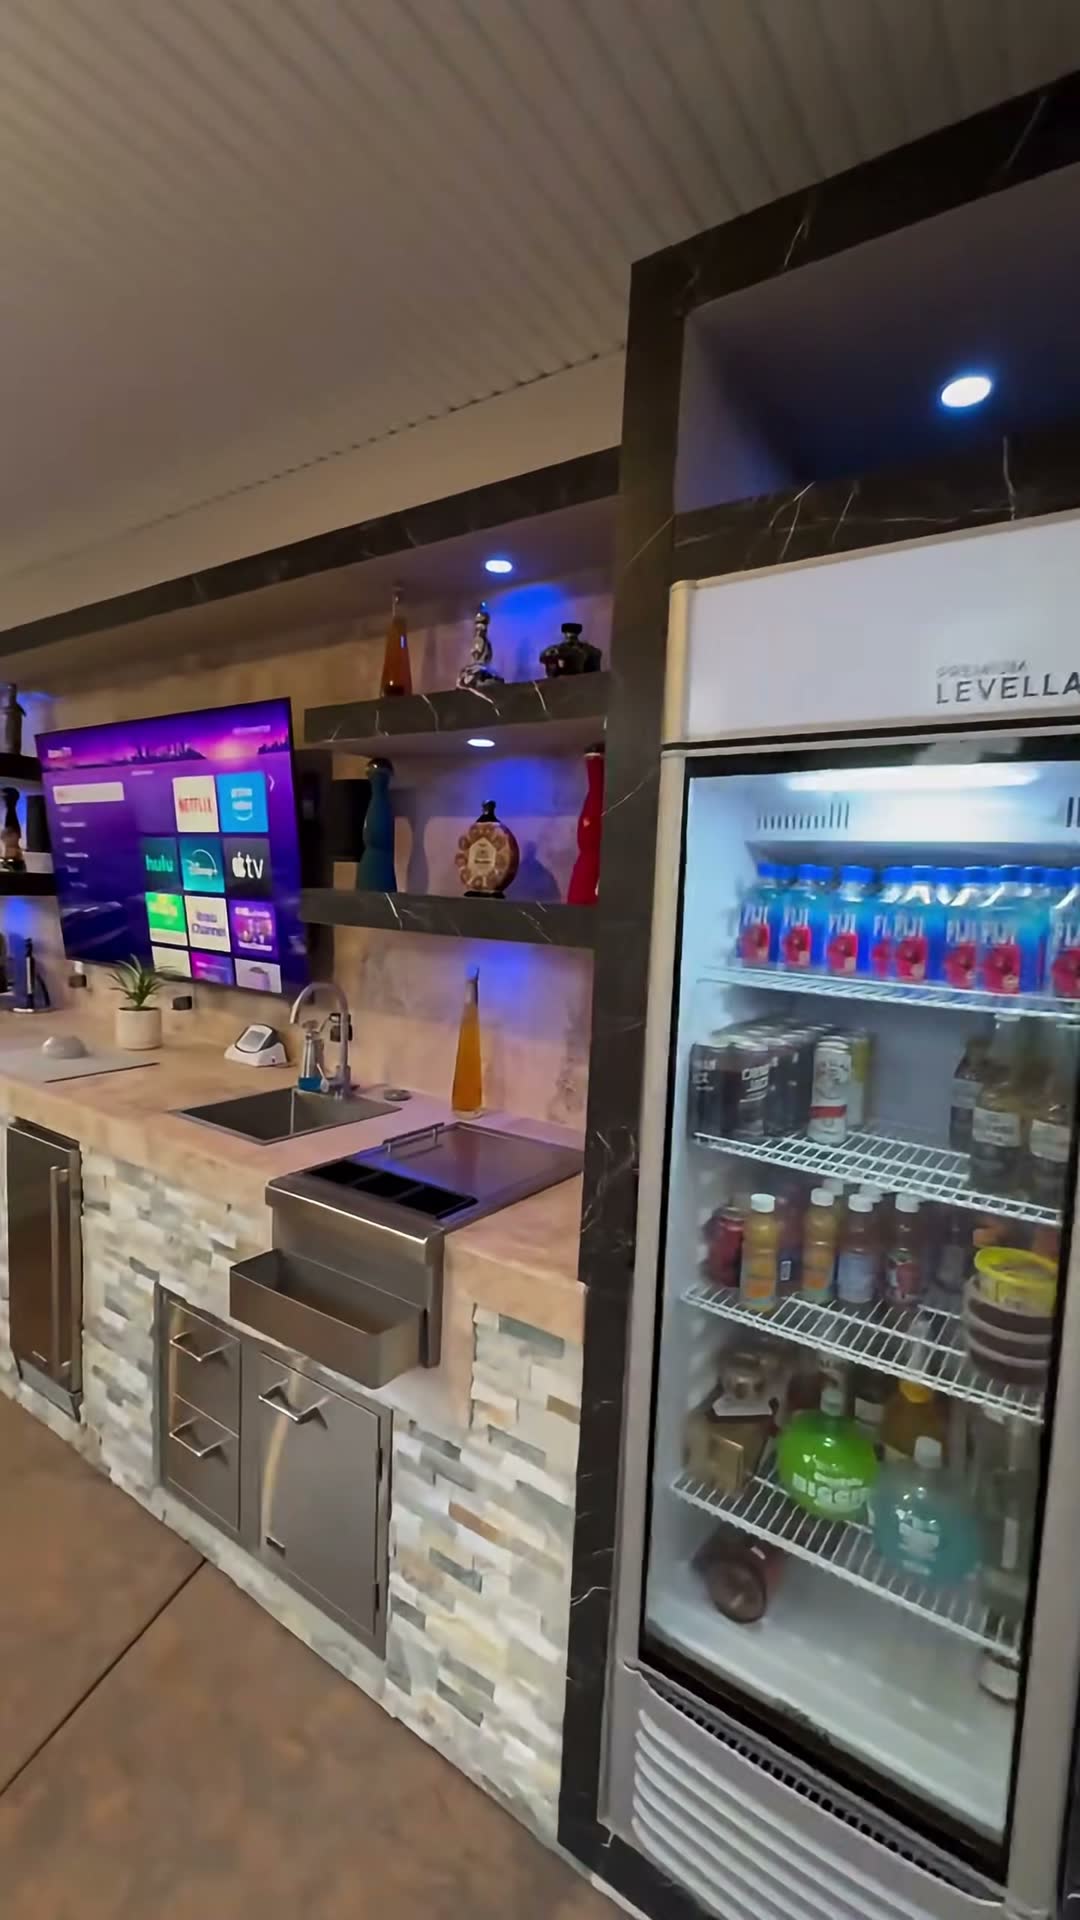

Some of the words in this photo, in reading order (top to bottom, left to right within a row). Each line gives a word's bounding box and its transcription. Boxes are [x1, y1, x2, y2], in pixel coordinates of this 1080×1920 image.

[936, 672, 1080, 705] LEVELLA
[146, 854, 174, 872] hulu
[245, 854, 264, 879] tv
[783, 906, 809, 927] FIJI
[829, 912, 857, 934] FIJI
